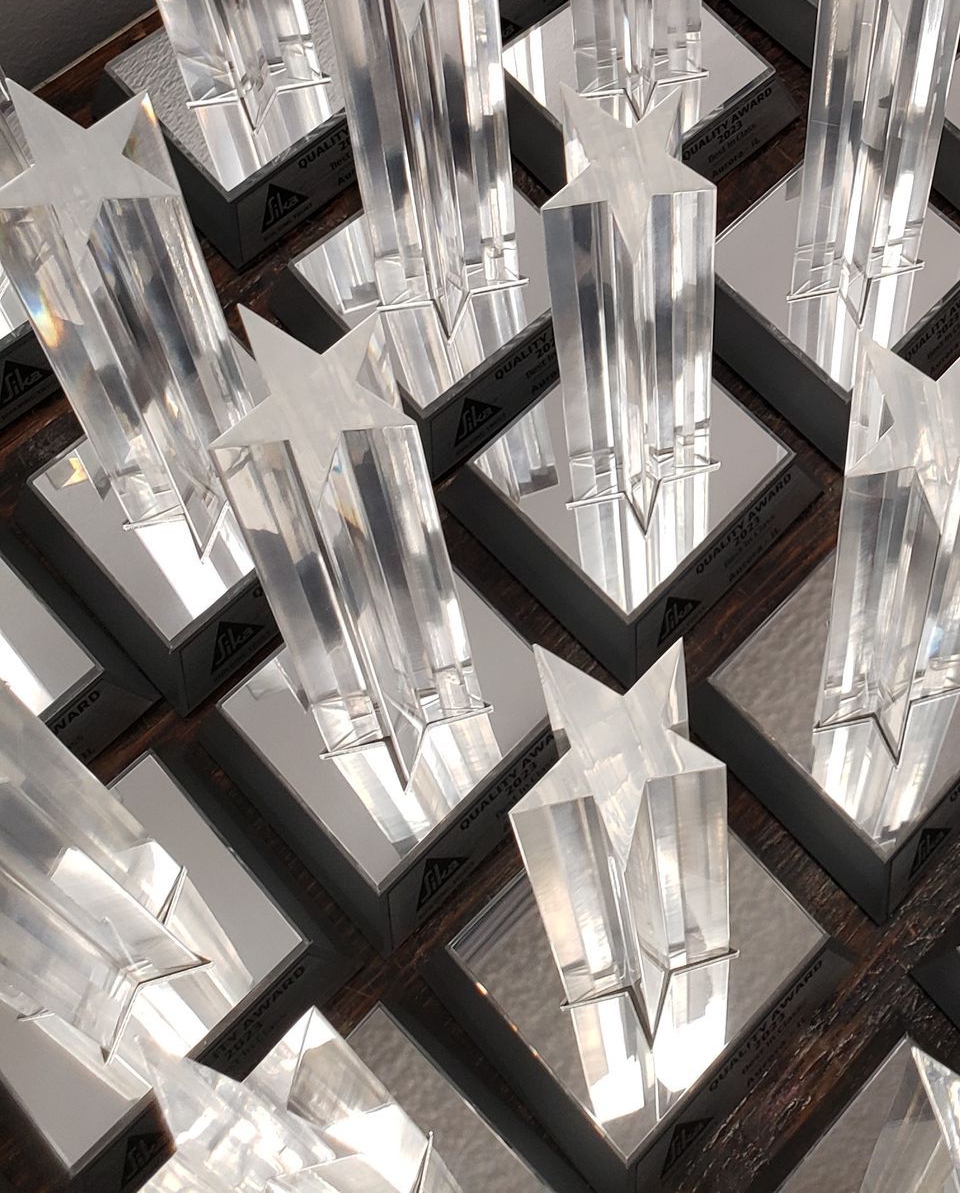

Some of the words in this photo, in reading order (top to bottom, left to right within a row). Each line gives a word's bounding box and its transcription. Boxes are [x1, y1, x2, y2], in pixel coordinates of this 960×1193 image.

[682, 121, 729, 161] QUALITY
[732, 87, 772, 123] AWARD
[717, 120, 743, 144] 2023
[298, 127, 348, 168] QUALITY
[905, 315, 947, 362] QUALITY
[936, 311, 960, 340] 2023
[495, 333, 547, 380] QUALITY
[2, 367, 44, 403] Sika
[696, 520, 744, 575] QUALITY
[749, 473, 792, 521] AWARD
[734, 515, 761, 546] 2023
[54, 690, 100, 735] WARD
[460, 769, 518, 830] QUALITY
[522, 734, 554, 769] AWA
[505, 761, 537, 796] 2023
[244, 966, 305, 1030] AWARD
[708, 1023, 767, 1092] QUALITY
[771, 960, 823, 1021] AWARD
